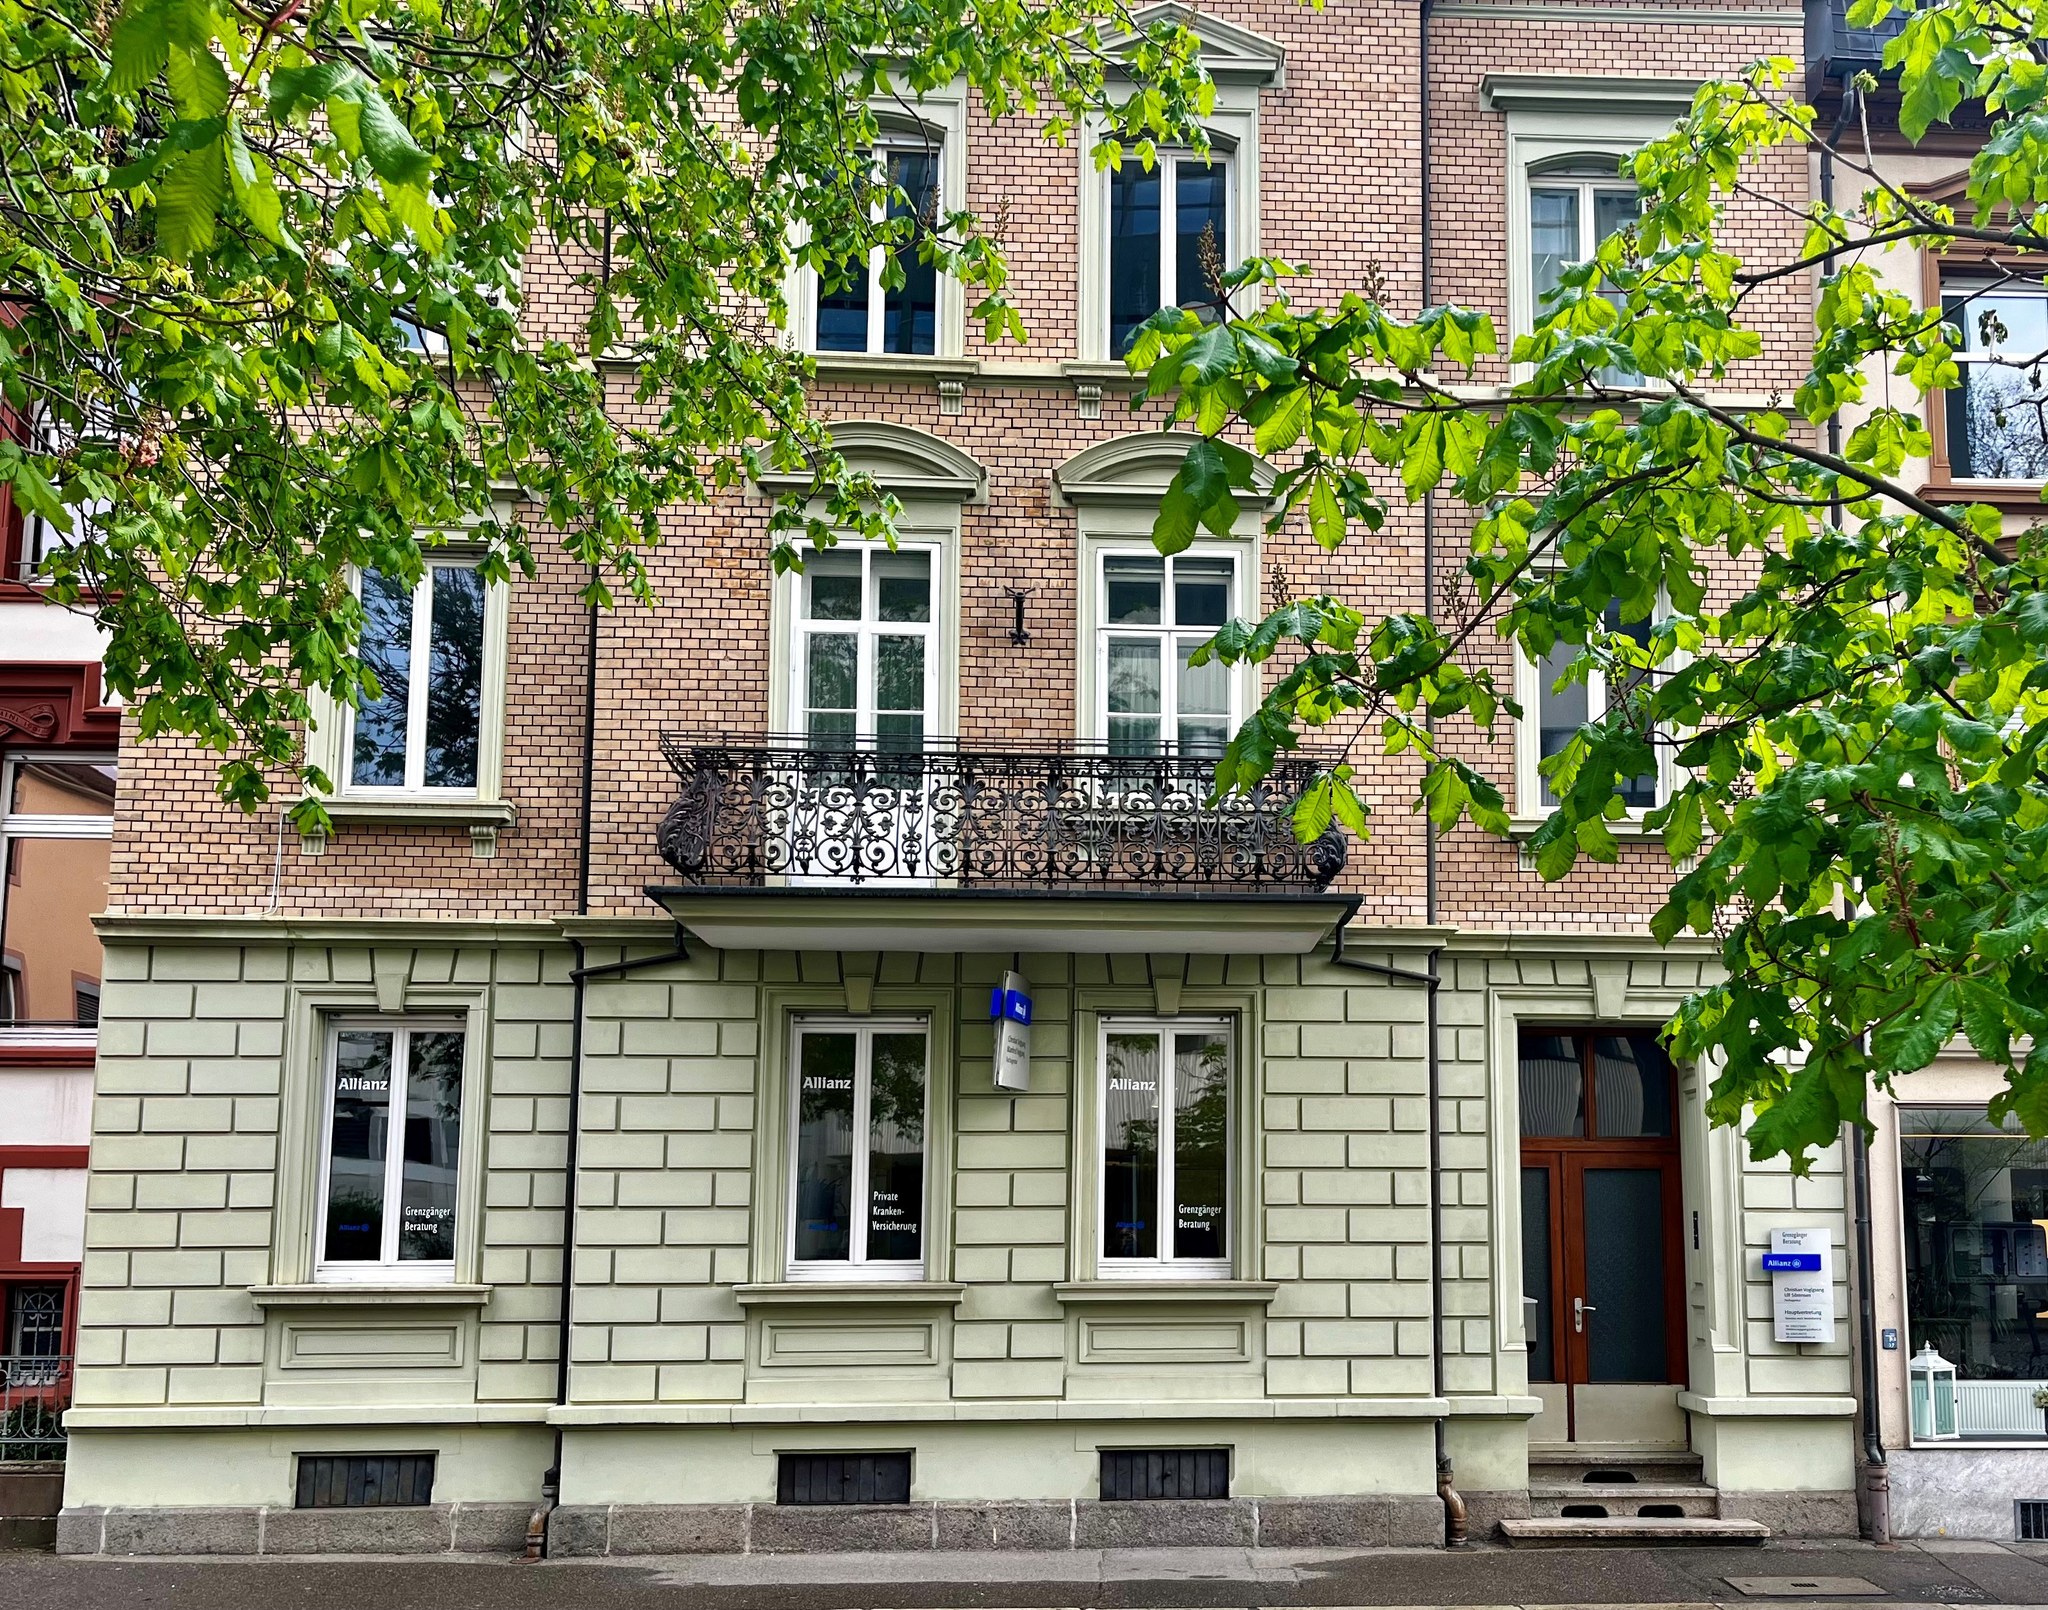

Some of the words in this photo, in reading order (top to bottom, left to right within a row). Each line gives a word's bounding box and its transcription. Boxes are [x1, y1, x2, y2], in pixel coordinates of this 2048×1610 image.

[338, 1077, 388, 1091] Allianz
[803, 1076, 852, 1089] Allianz
[1109, 1078, 1156, 1091] Allianz
[873, 1190, 899, 1201] Private
[405, 1205, 451, 1219] Grenzgänger
[872, 1205, 905, 1216] Kranken-
[1178, 1203, 1222, 1216] Grenzgänger
[404, 1221, 438, 1234] Beratung
[872, 1220, 917, 1233] Versicherung
[1178, 1218, 1210, 1231] Beratung
